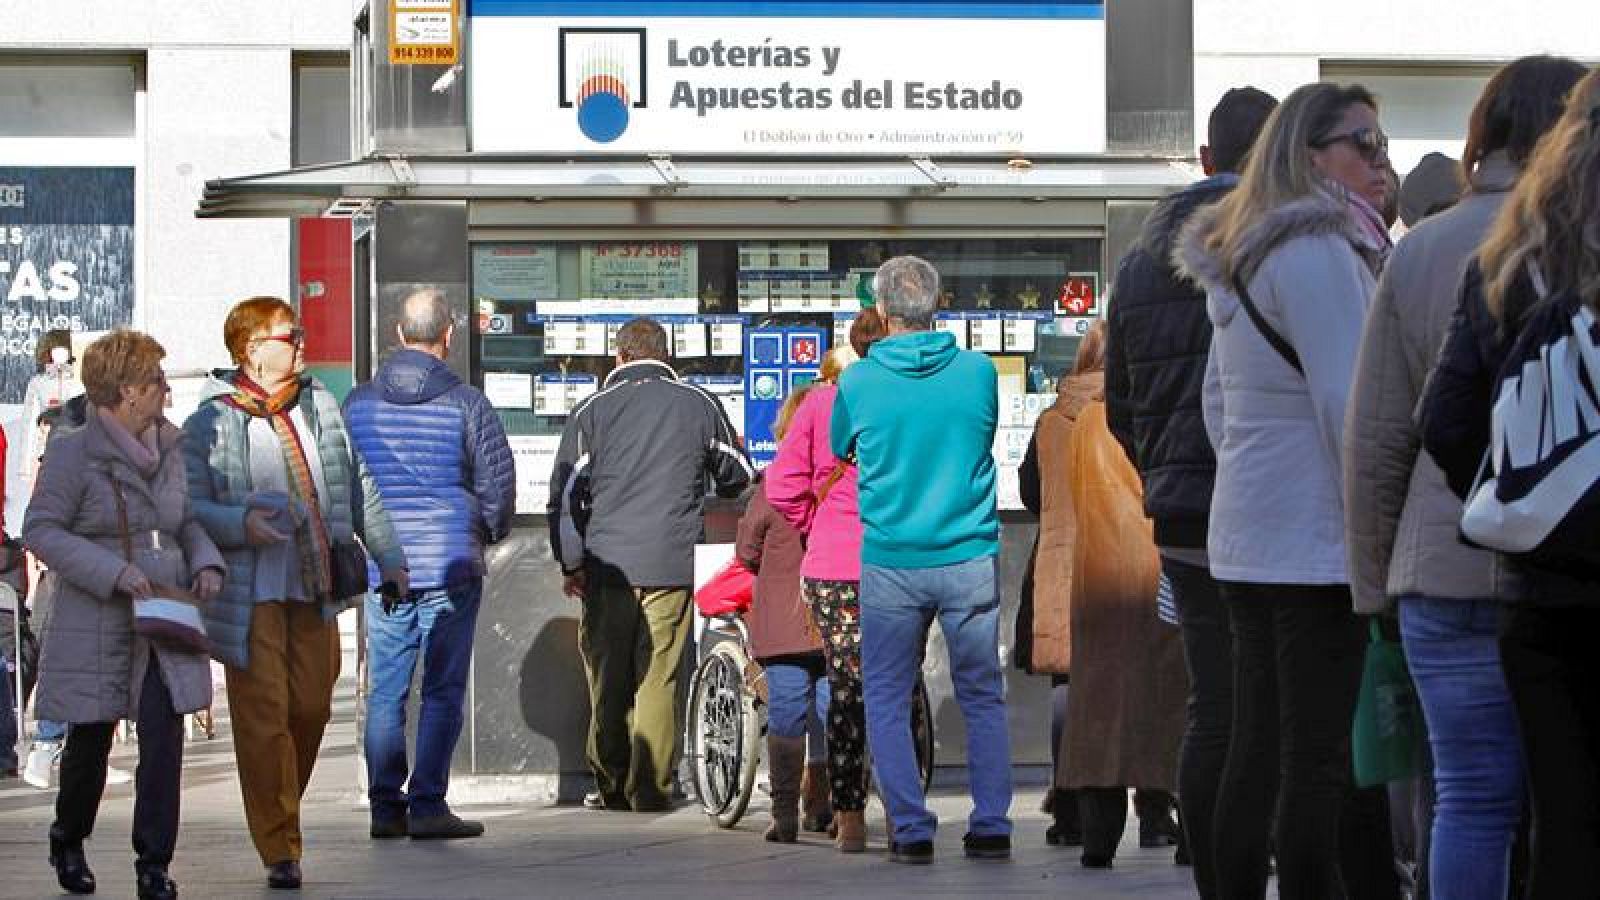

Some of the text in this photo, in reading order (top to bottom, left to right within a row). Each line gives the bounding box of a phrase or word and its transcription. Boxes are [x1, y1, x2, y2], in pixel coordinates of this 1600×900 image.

[667, 37, 841, 76] Loterías y
[669, 80, 1023, 117] Apuestas del Estado
[815, 130, 832, 143] de
[836, 131, 863, 143] Oro
